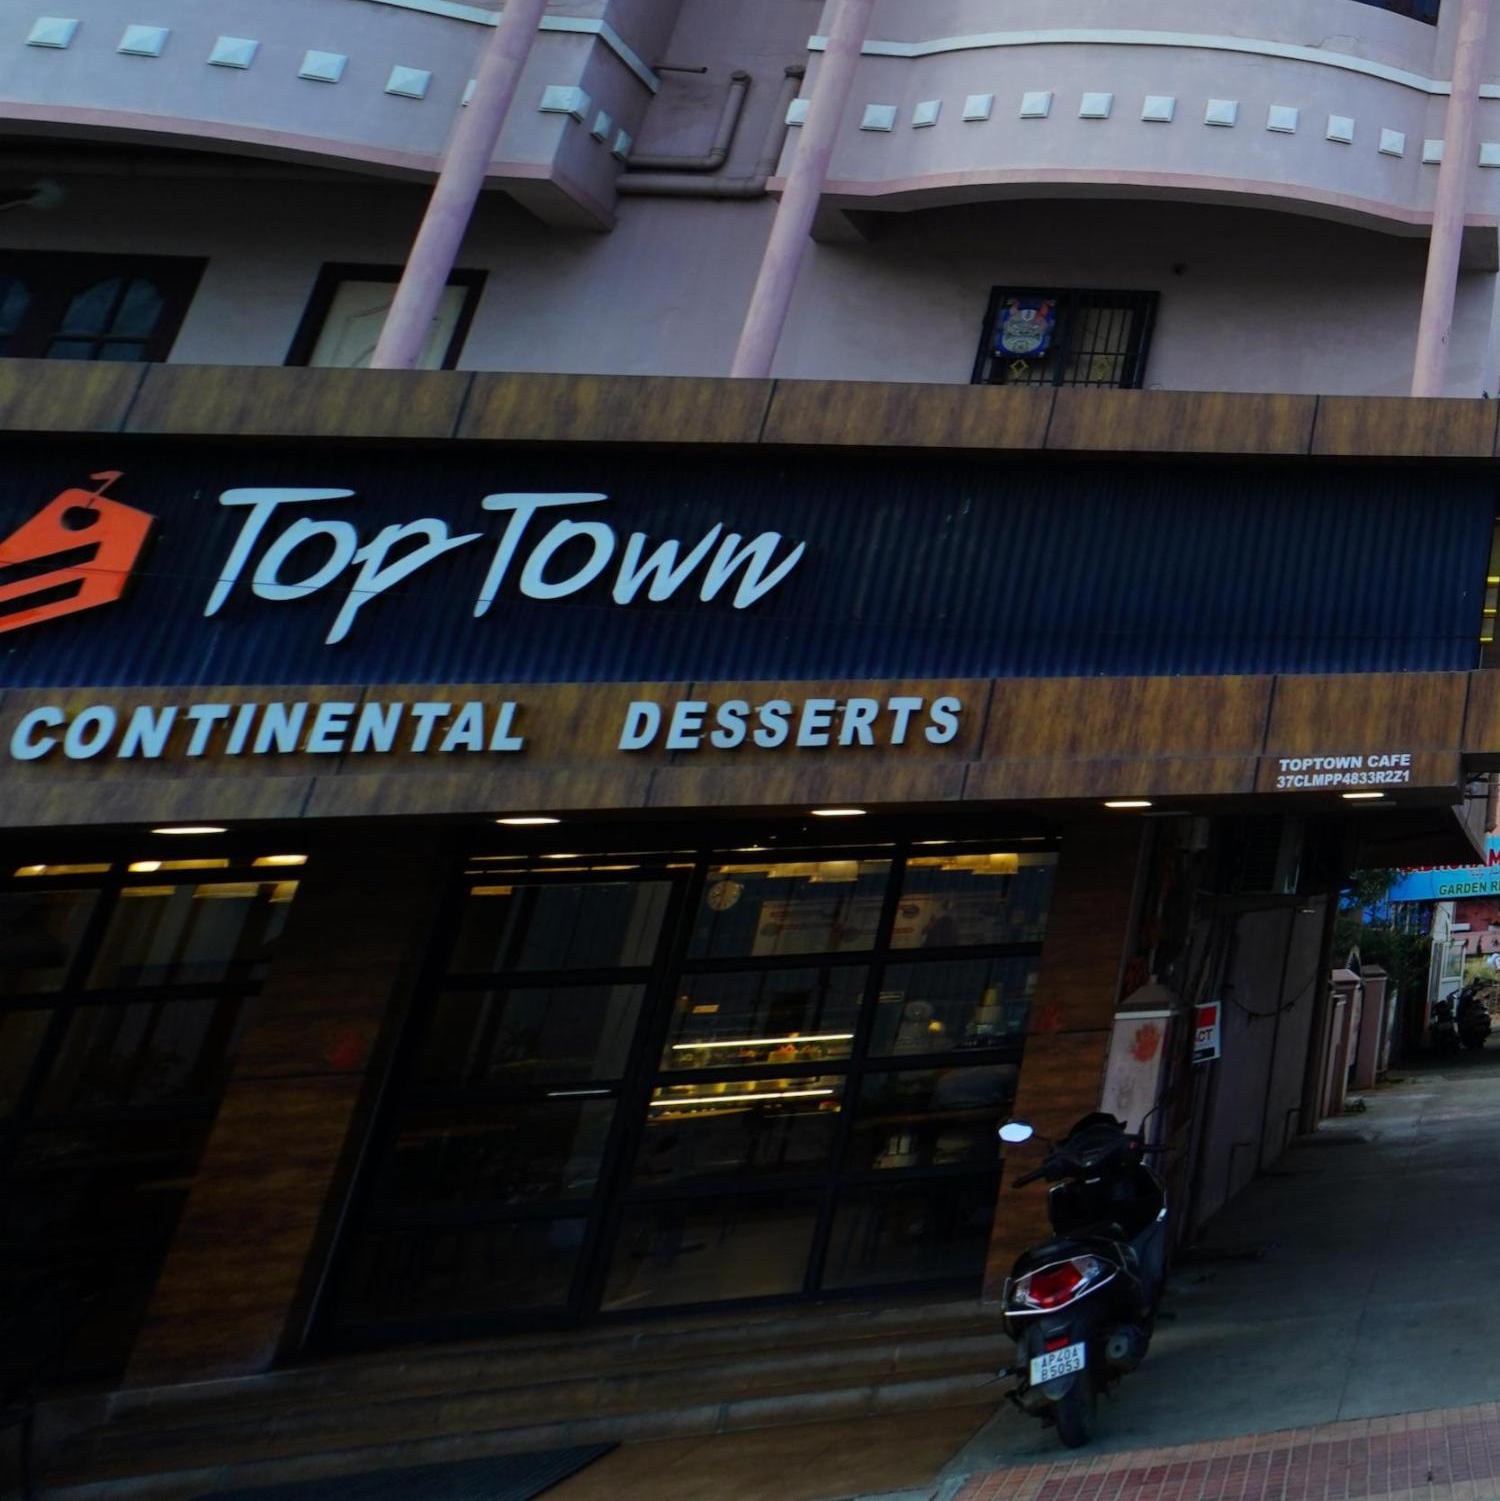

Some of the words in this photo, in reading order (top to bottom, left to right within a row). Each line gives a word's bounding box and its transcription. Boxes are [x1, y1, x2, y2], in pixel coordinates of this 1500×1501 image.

[9, 702, 526, 762] CONTINENTAL
[619, 696, 962, 752] DESSERTS
[1279, 755, 1362, 771] TOPTOWN
[1367, 753, 1411, 768] CAFE
[1440, 881, 1487, 895] GARDEN
